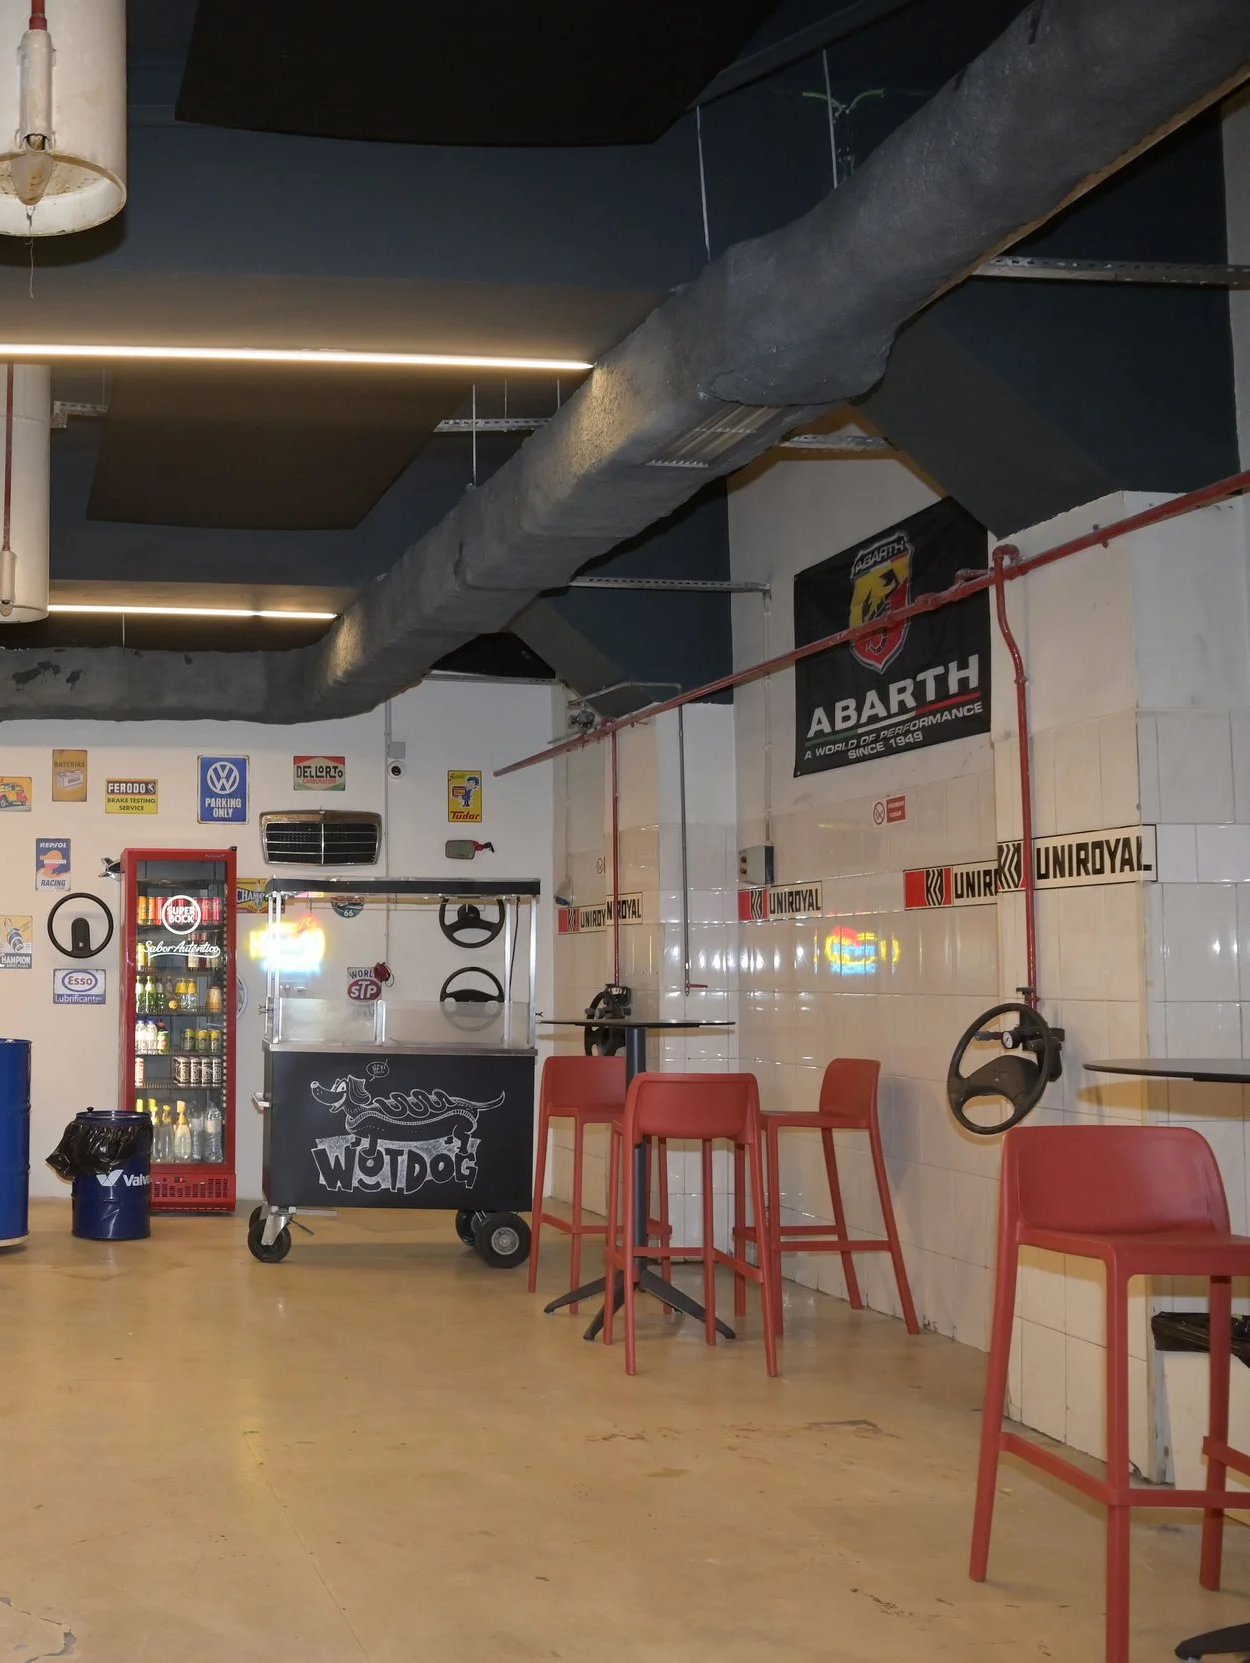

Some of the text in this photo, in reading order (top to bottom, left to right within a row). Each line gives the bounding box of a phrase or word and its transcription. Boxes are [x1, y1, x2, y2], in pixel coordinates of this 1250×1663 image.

[855, 540, 905, 573] ABARTH
[806, 654, 979, 739] ABARTH
[804, 701, 983, 760] A WORLD OF PERFORMANCE
[848, 731, 923, 760] SINCE 1949
[108, 782, 146, 793] FERODO
[205, 797, 242, 808] PARKING
[213, 808, 233, 818] ONLY
[450, 810, 480, 820] Tudor
[1036, 835, 1152, 881] UNIROYAL
[40, 879, 66, 887] RACING
[237, 888, 264, 903] CHAMP
[769, 888, 821, 914] UNIROYAL
[167, 906, 196, 915] SUPER
[343, 909, 354, 917] 66
[169, 914, 196, 924] BOCK
[144, 940, 172, 953] Sabor
[350, 969, 374, 980] WORL
[67, 975, 93, 986] Esso
[350, 981, 378, 1000] STP
